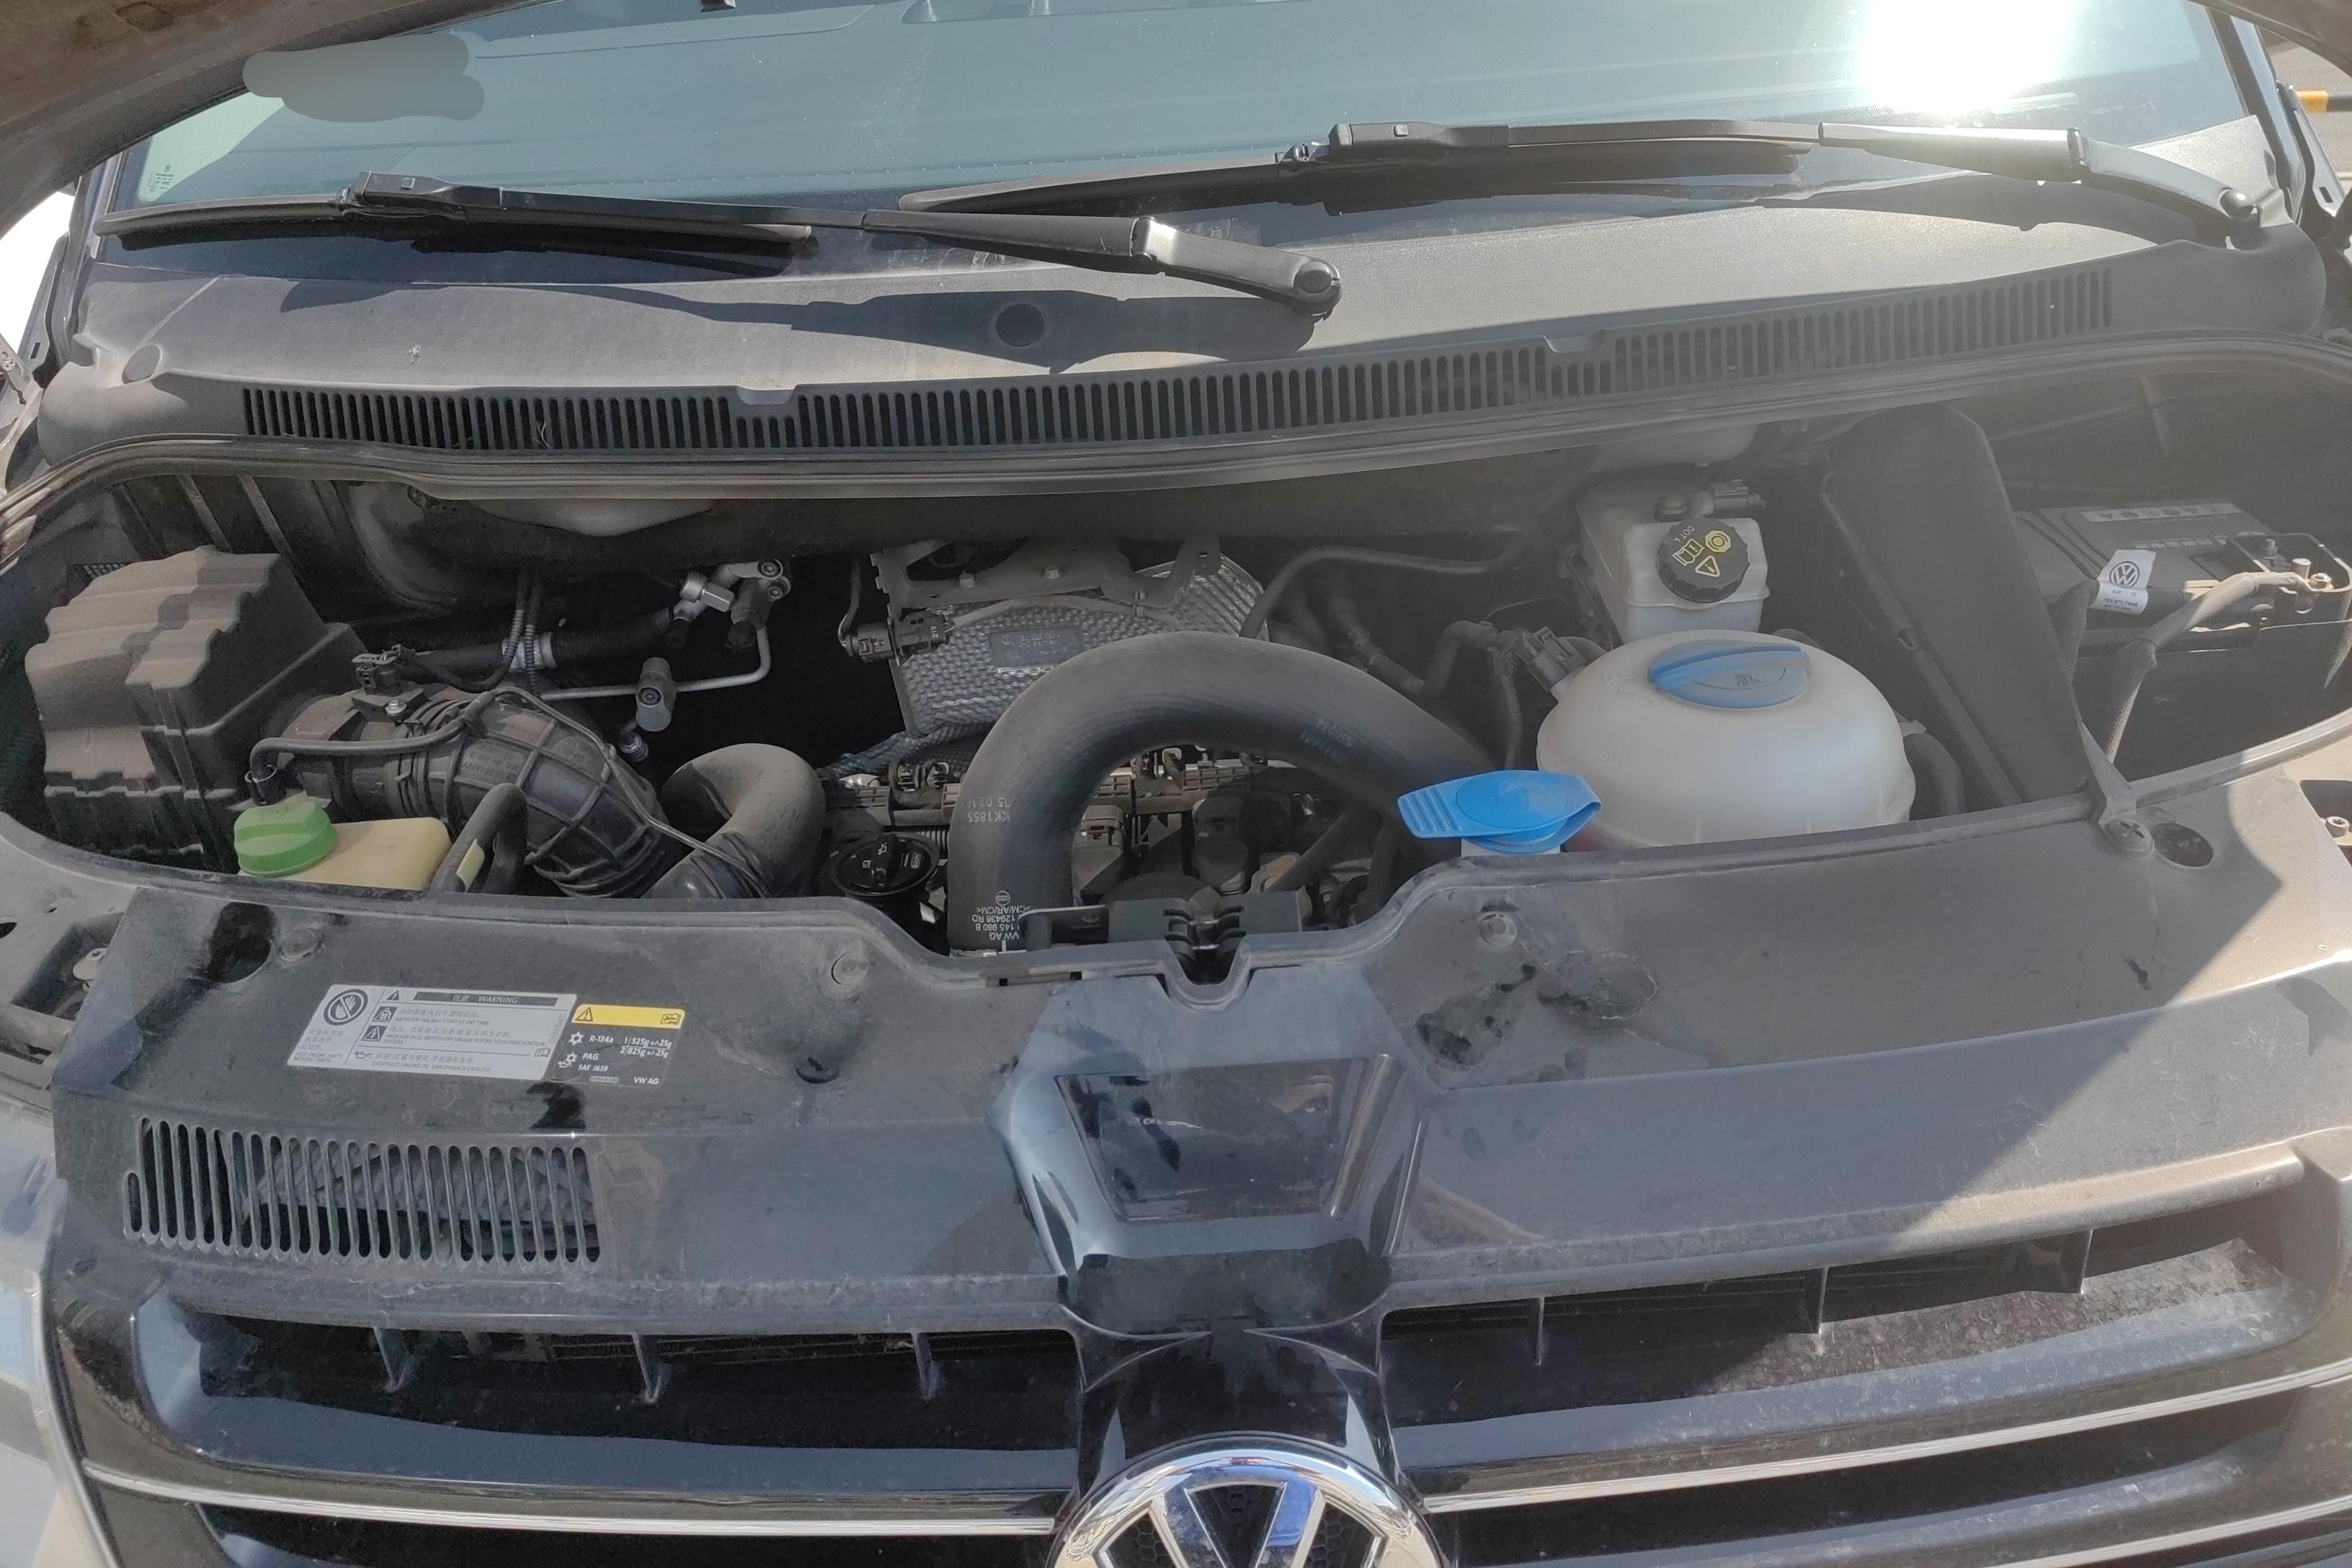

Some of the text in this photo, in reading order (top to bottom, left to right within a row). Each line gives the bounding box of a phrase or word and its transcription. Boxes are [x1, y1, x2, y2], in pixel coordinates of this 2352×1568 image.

[1680, 525, 1695, 539] DOT
[989, 932, 1020, 940] VW AG
[478, 995, 519, 1004] WARNING
